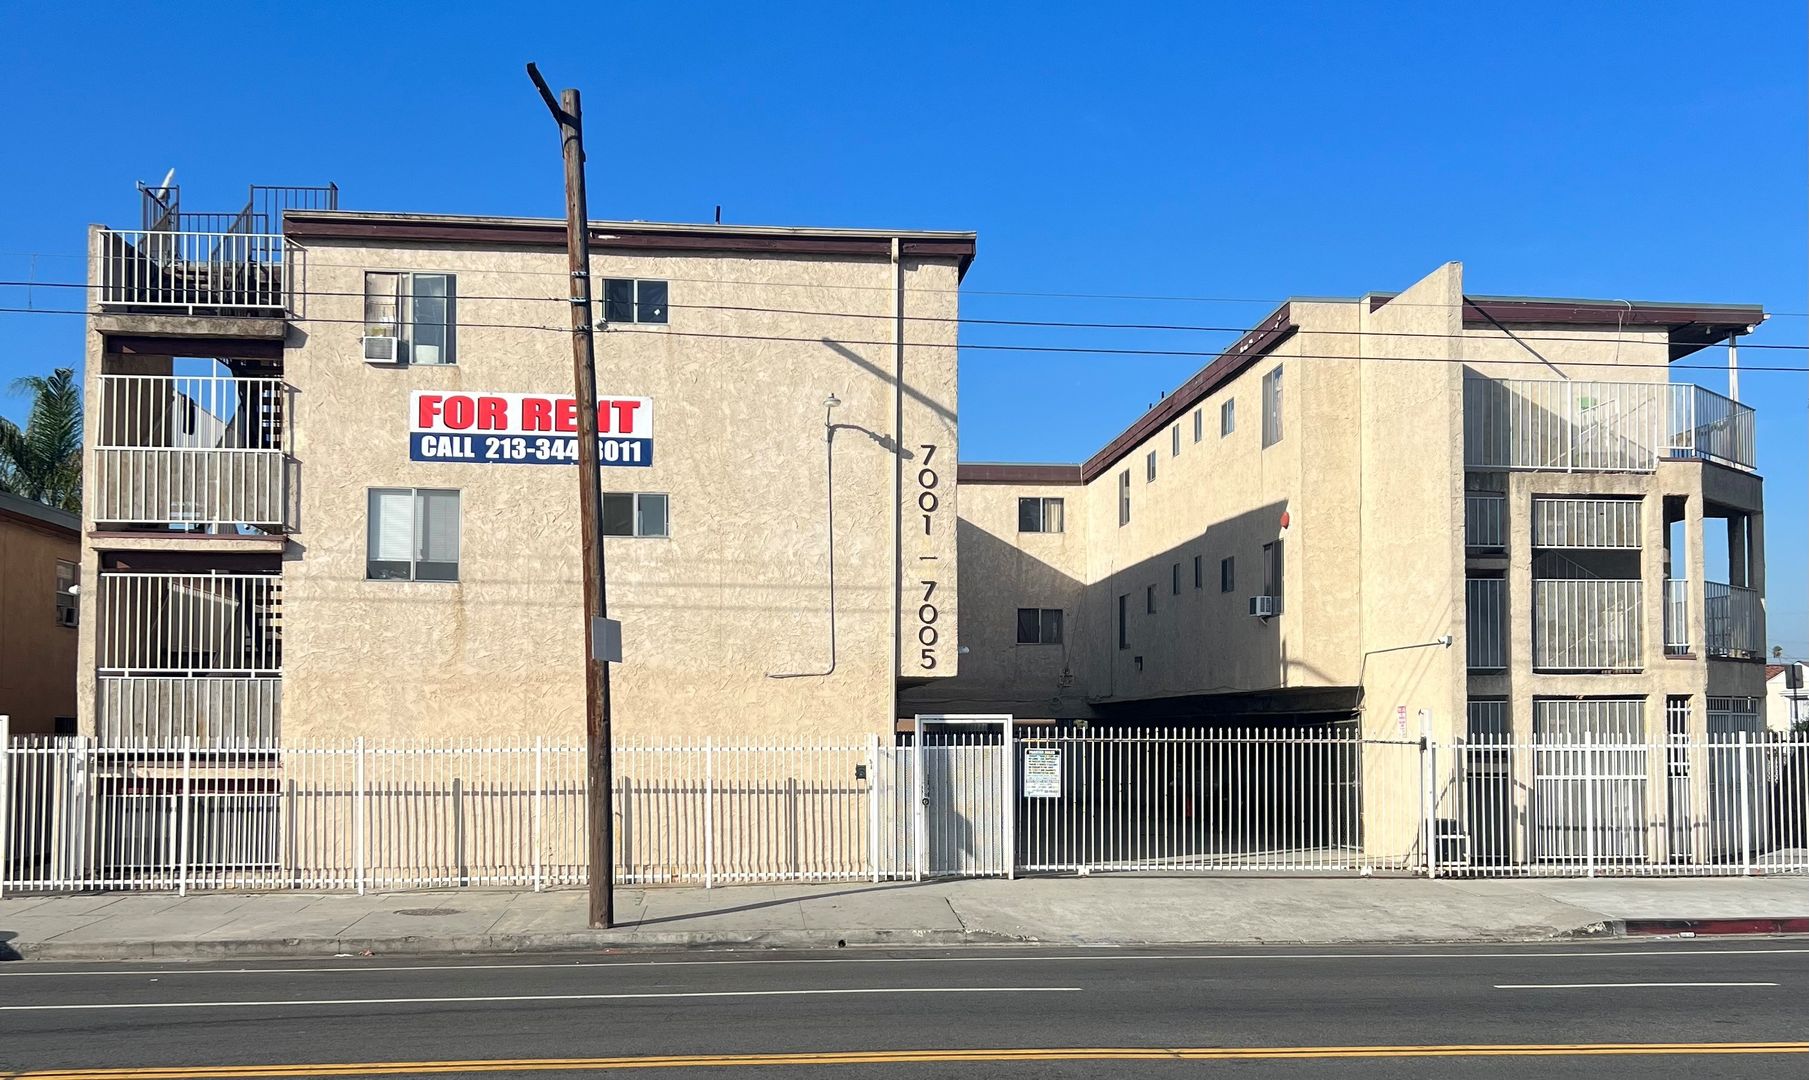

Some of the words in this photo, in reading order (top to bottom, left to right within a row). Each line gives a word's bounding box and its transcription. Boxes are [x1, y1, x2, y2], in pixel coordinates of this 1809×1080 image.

[418, 395, 509, 431] FOR
[421, 435, 475, 458] CALL
[485, 437, 641, 462] 213-344011
[918, 444, 939, 536] 7001
[918, 580, 939, 670] 7005
